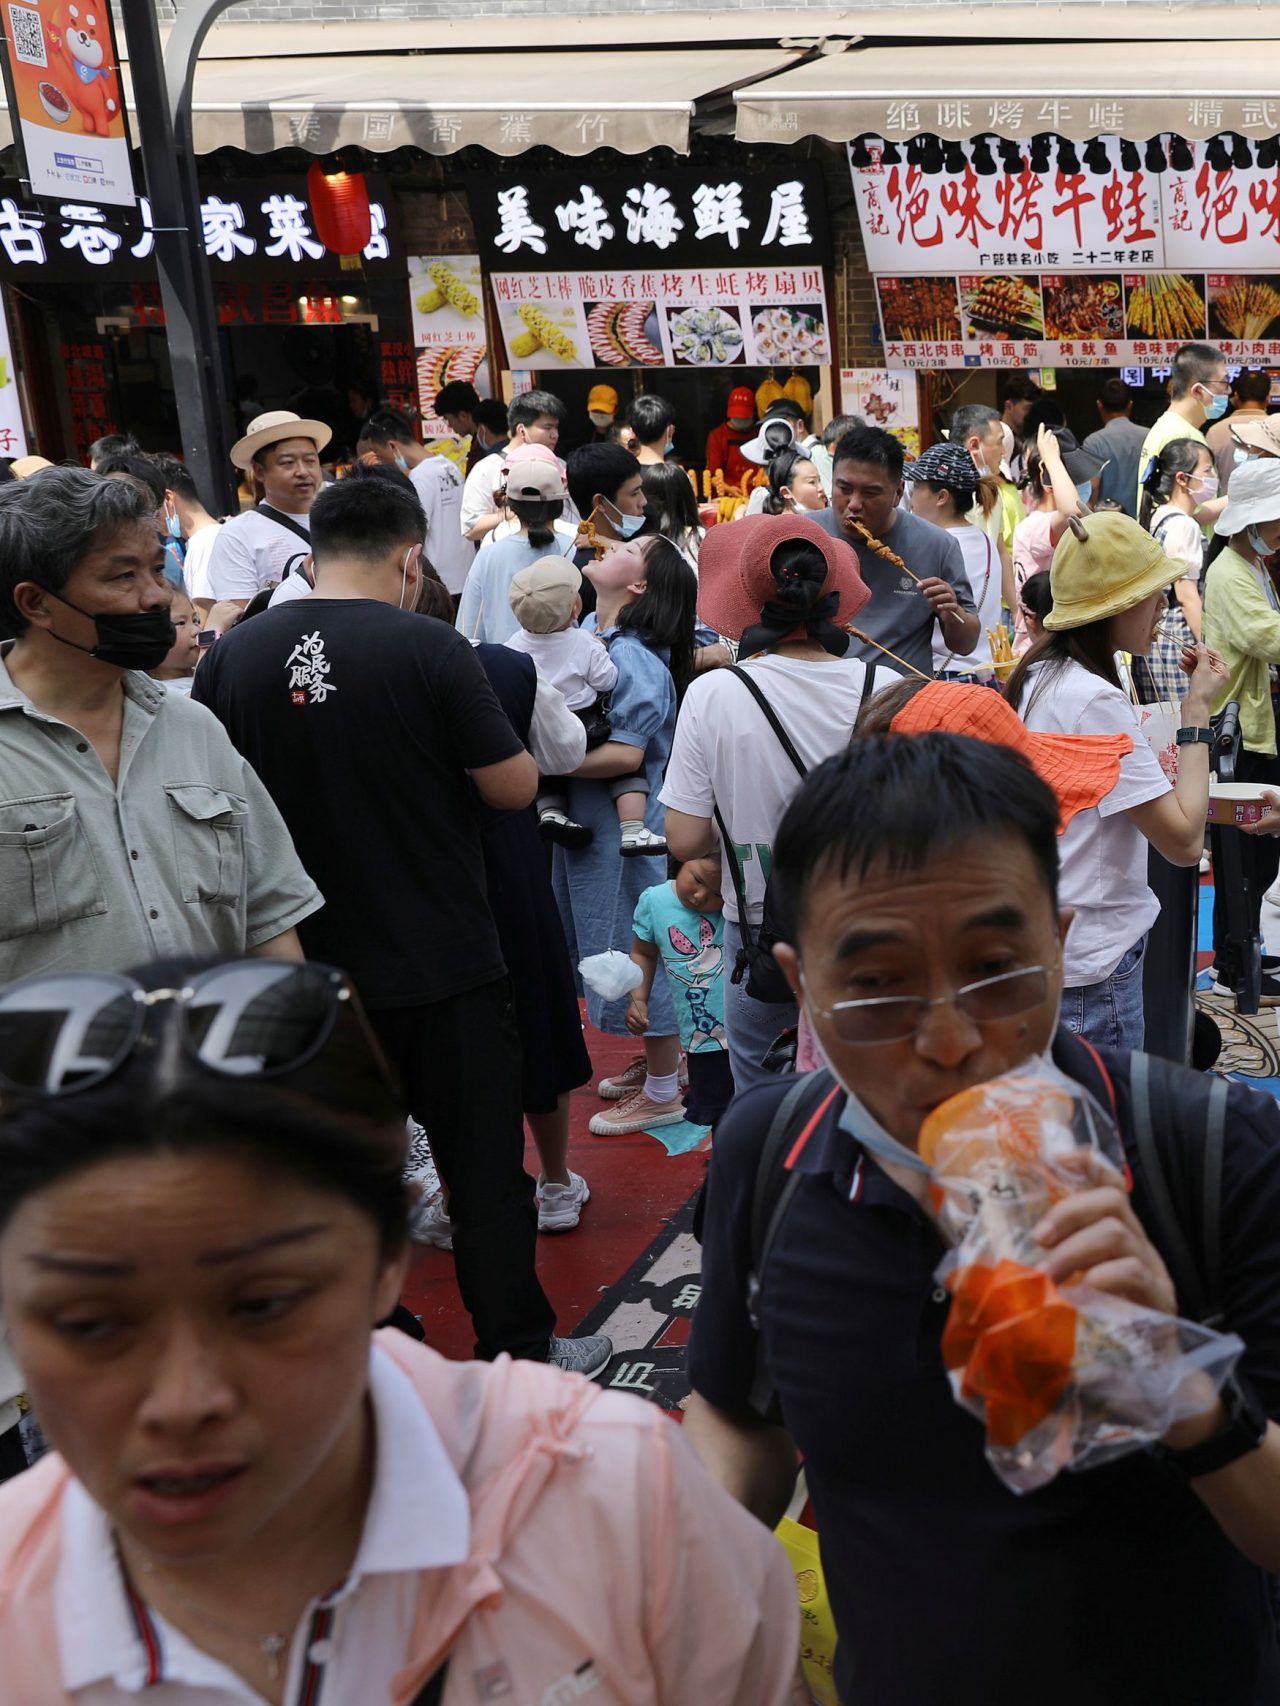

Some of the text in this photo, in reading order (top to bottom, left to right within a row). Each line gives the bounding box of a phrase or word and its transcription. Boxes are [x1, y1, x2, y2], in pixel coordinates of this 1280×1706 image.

[885, 99, 1125, 131] 绝味烤牛蛙
[494, 181, 814, 255] 美味海鲜屋
[979, 250, 1155, 266] 户部巷名小吃 二十二年老店
[495, 274, 574, 300] 网红芝士棒
[578, 273, 658, 298] 脆皮香蕉
[745, 270, 823, 297] 烤扇贝
[888, 344, 965, 357] 大西北肉串
[979, 343, 1038, 356] 烤面筋
[1060, 343, 1118, 355] 烤鱿鱼
[1133, 341, 1197, 355] 绝味鸭
